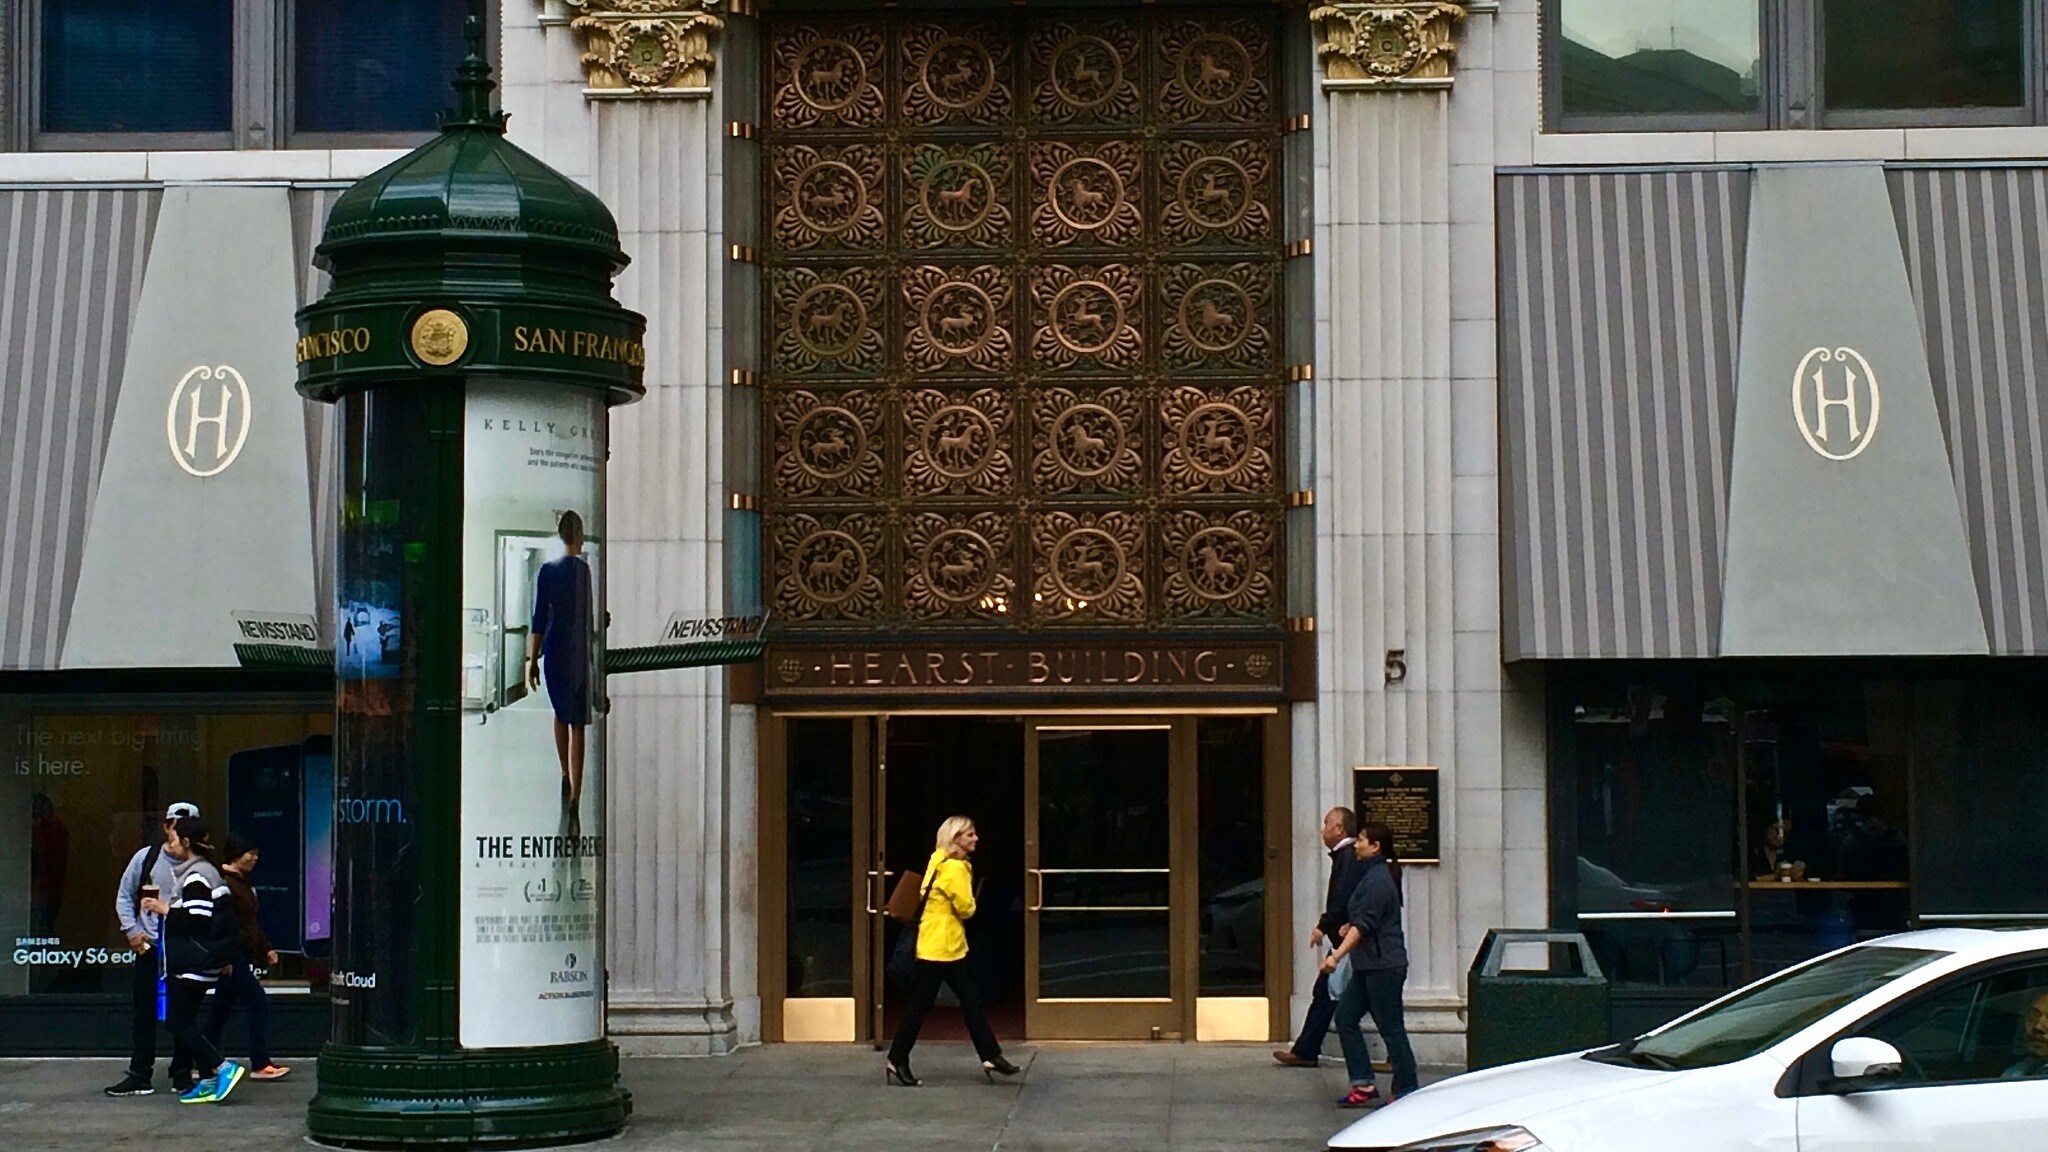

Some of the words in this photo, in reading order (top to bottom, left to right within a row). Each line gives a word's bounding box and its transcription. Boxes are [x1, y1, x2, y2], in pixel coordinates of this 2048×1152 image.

[514, 325, 568, 354] SAN
[484, 418, 557, 435] KELLY
[237, 619, 316, 643] NEWSSTAND
[667, 614, 763, 640] NEWSSTAND
[829, 651, 1001, 685] HEARST
[1027, 650, 1219, 684] BUILDING
[1384, 649, 1407, 685] 5
[16, 724, 53, 746] The
[111, 725, 146, 752] big
[14, 755, 30, 776] is
[38, 752, 91, 776] here.
[476, 836, 514, 859] THE
[13, 948, 83, 968] Galaxy
[85, 948, 109, 965] S6
[345, 971, 376, 989] Cloud
